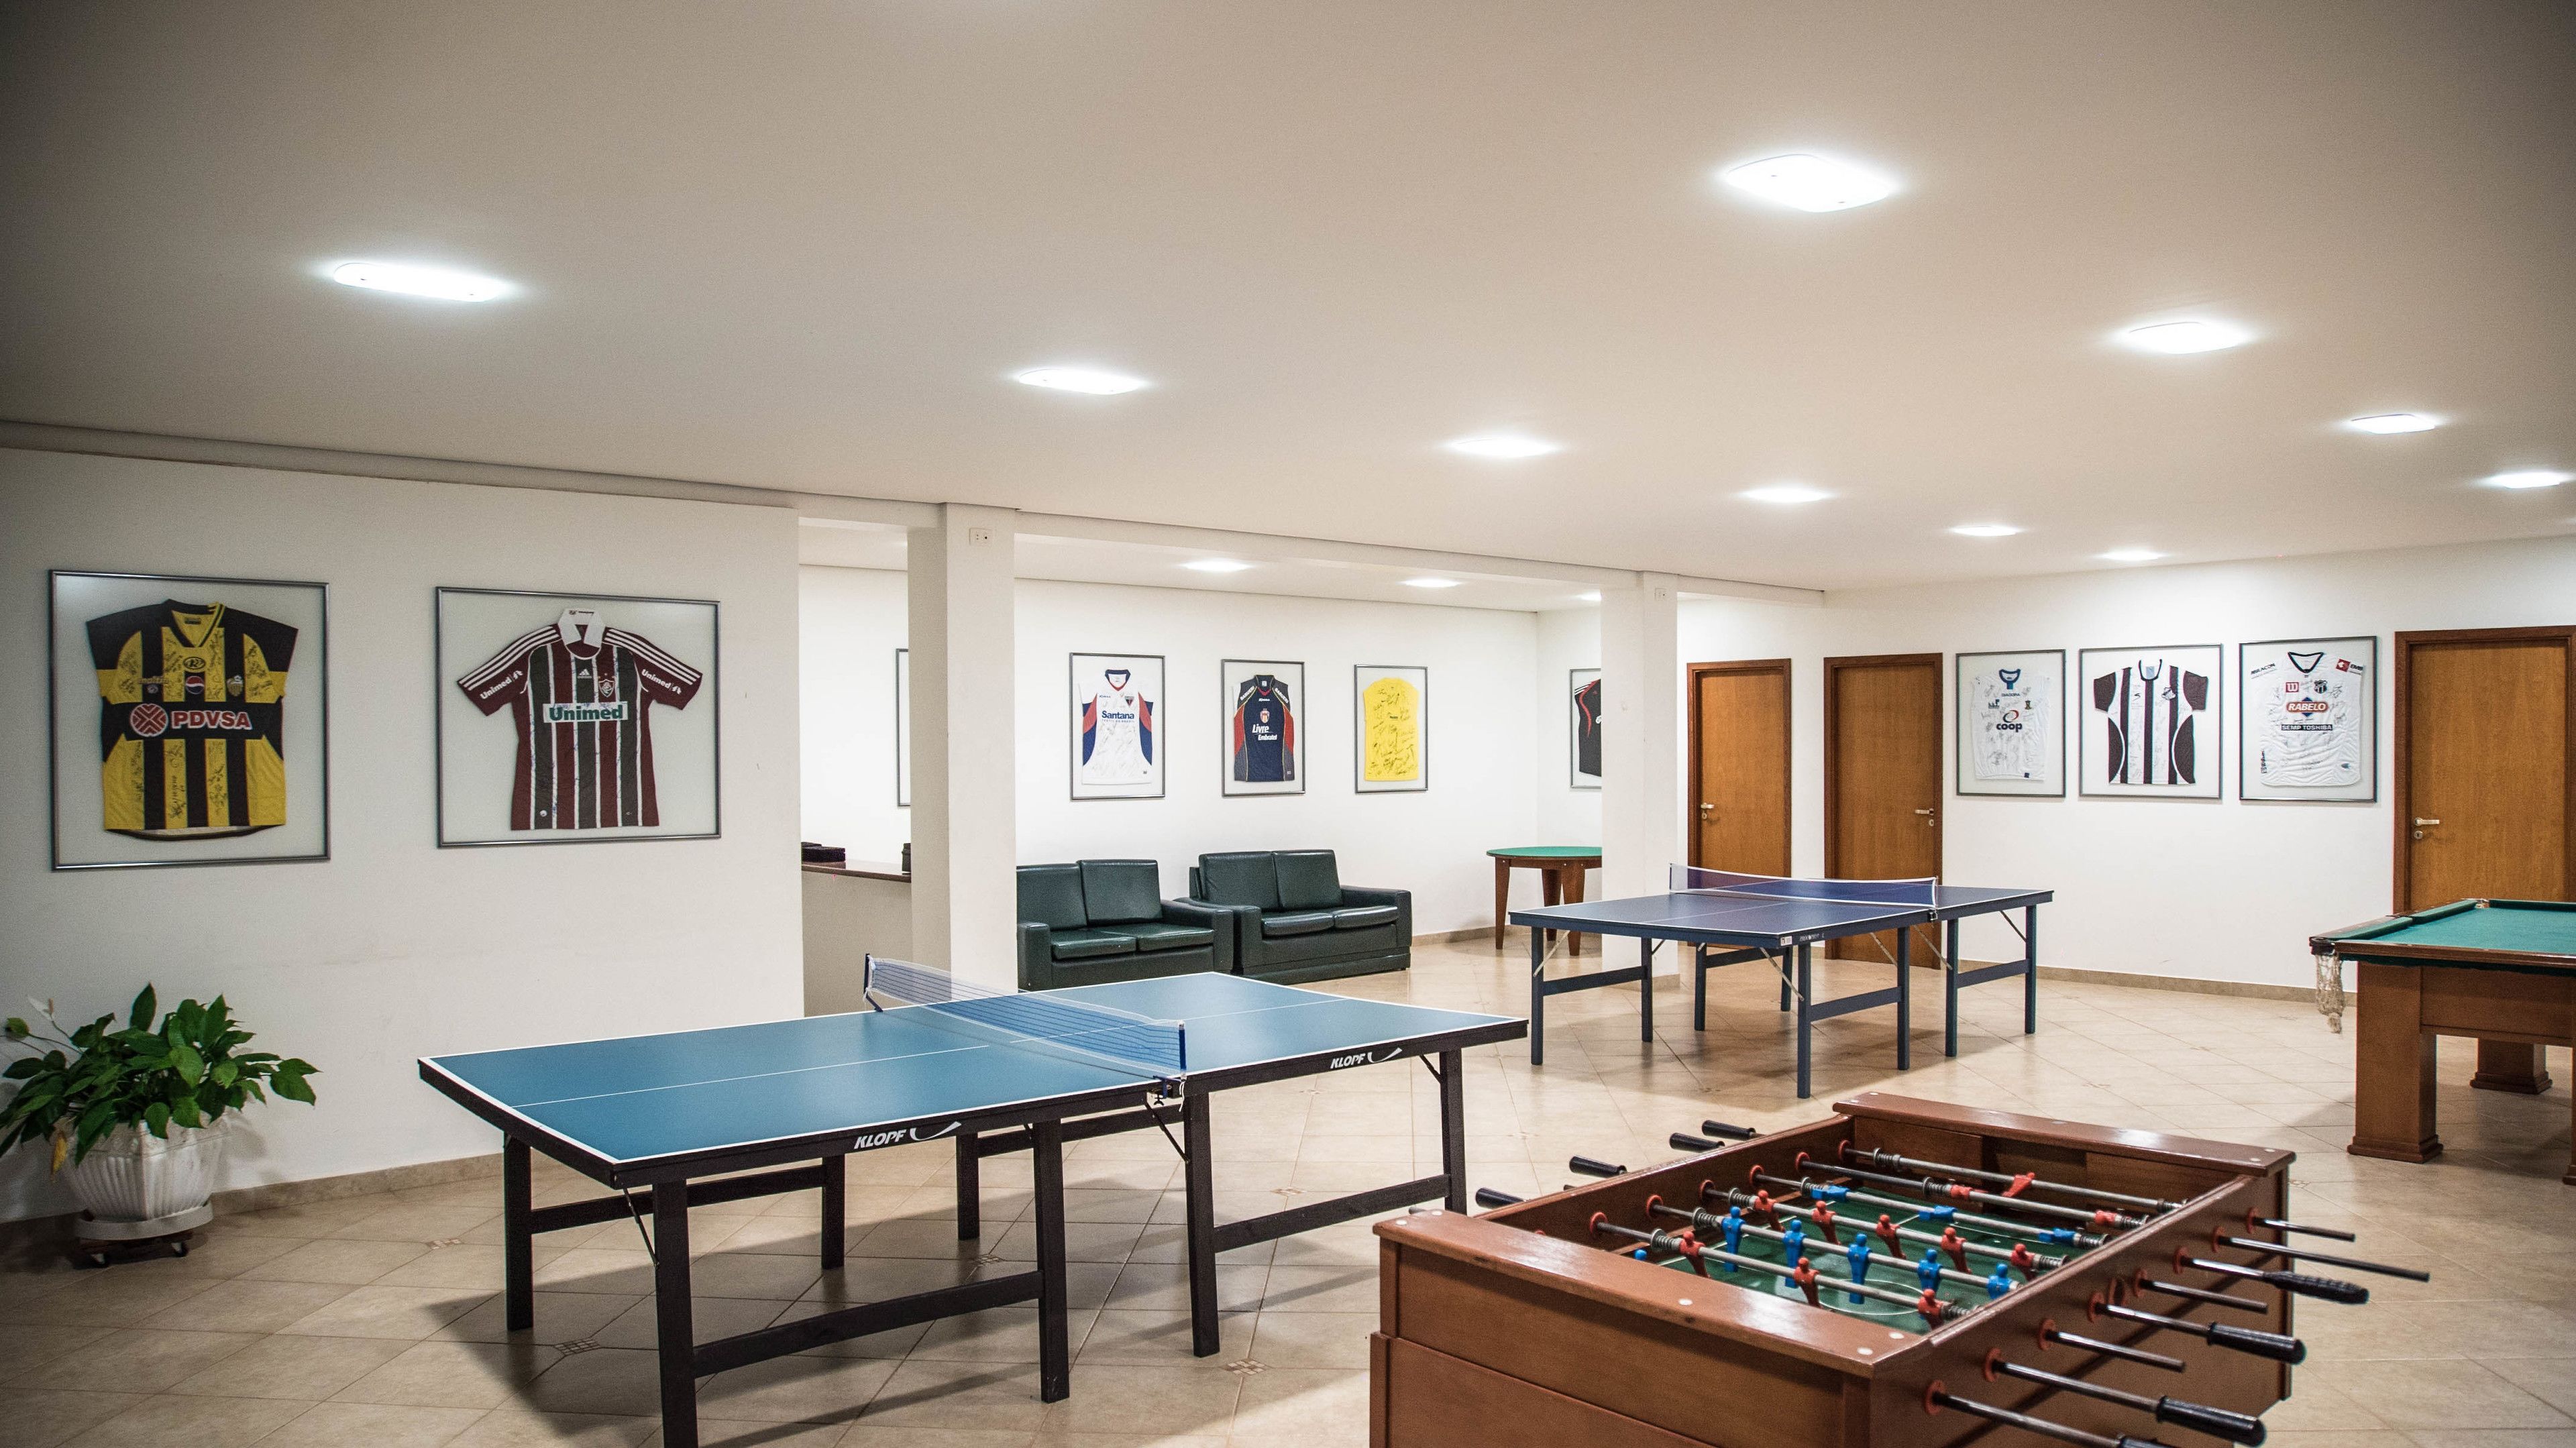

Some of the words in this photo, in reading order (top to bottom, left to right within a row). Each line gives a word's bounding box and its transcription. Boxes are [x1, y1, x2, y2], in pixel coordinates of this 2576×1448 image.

[480, 675, 512, 699] Unimed
[641, 669, 671, 689] Unimed
[549, 704, 623, 721] Unimed
[1102, 710, 1134, 720] Santana
[2288, 703, 2326, 711] RABELO
[171, 710, 252, 730] PDVSA
[1996, 723, 2023, 732] coop
[1252, 724, 1269, 734] Livre
[1330, 1053, 1366, 1069] KLOPF
[854, 1129, 906, 1149] KLOPF
